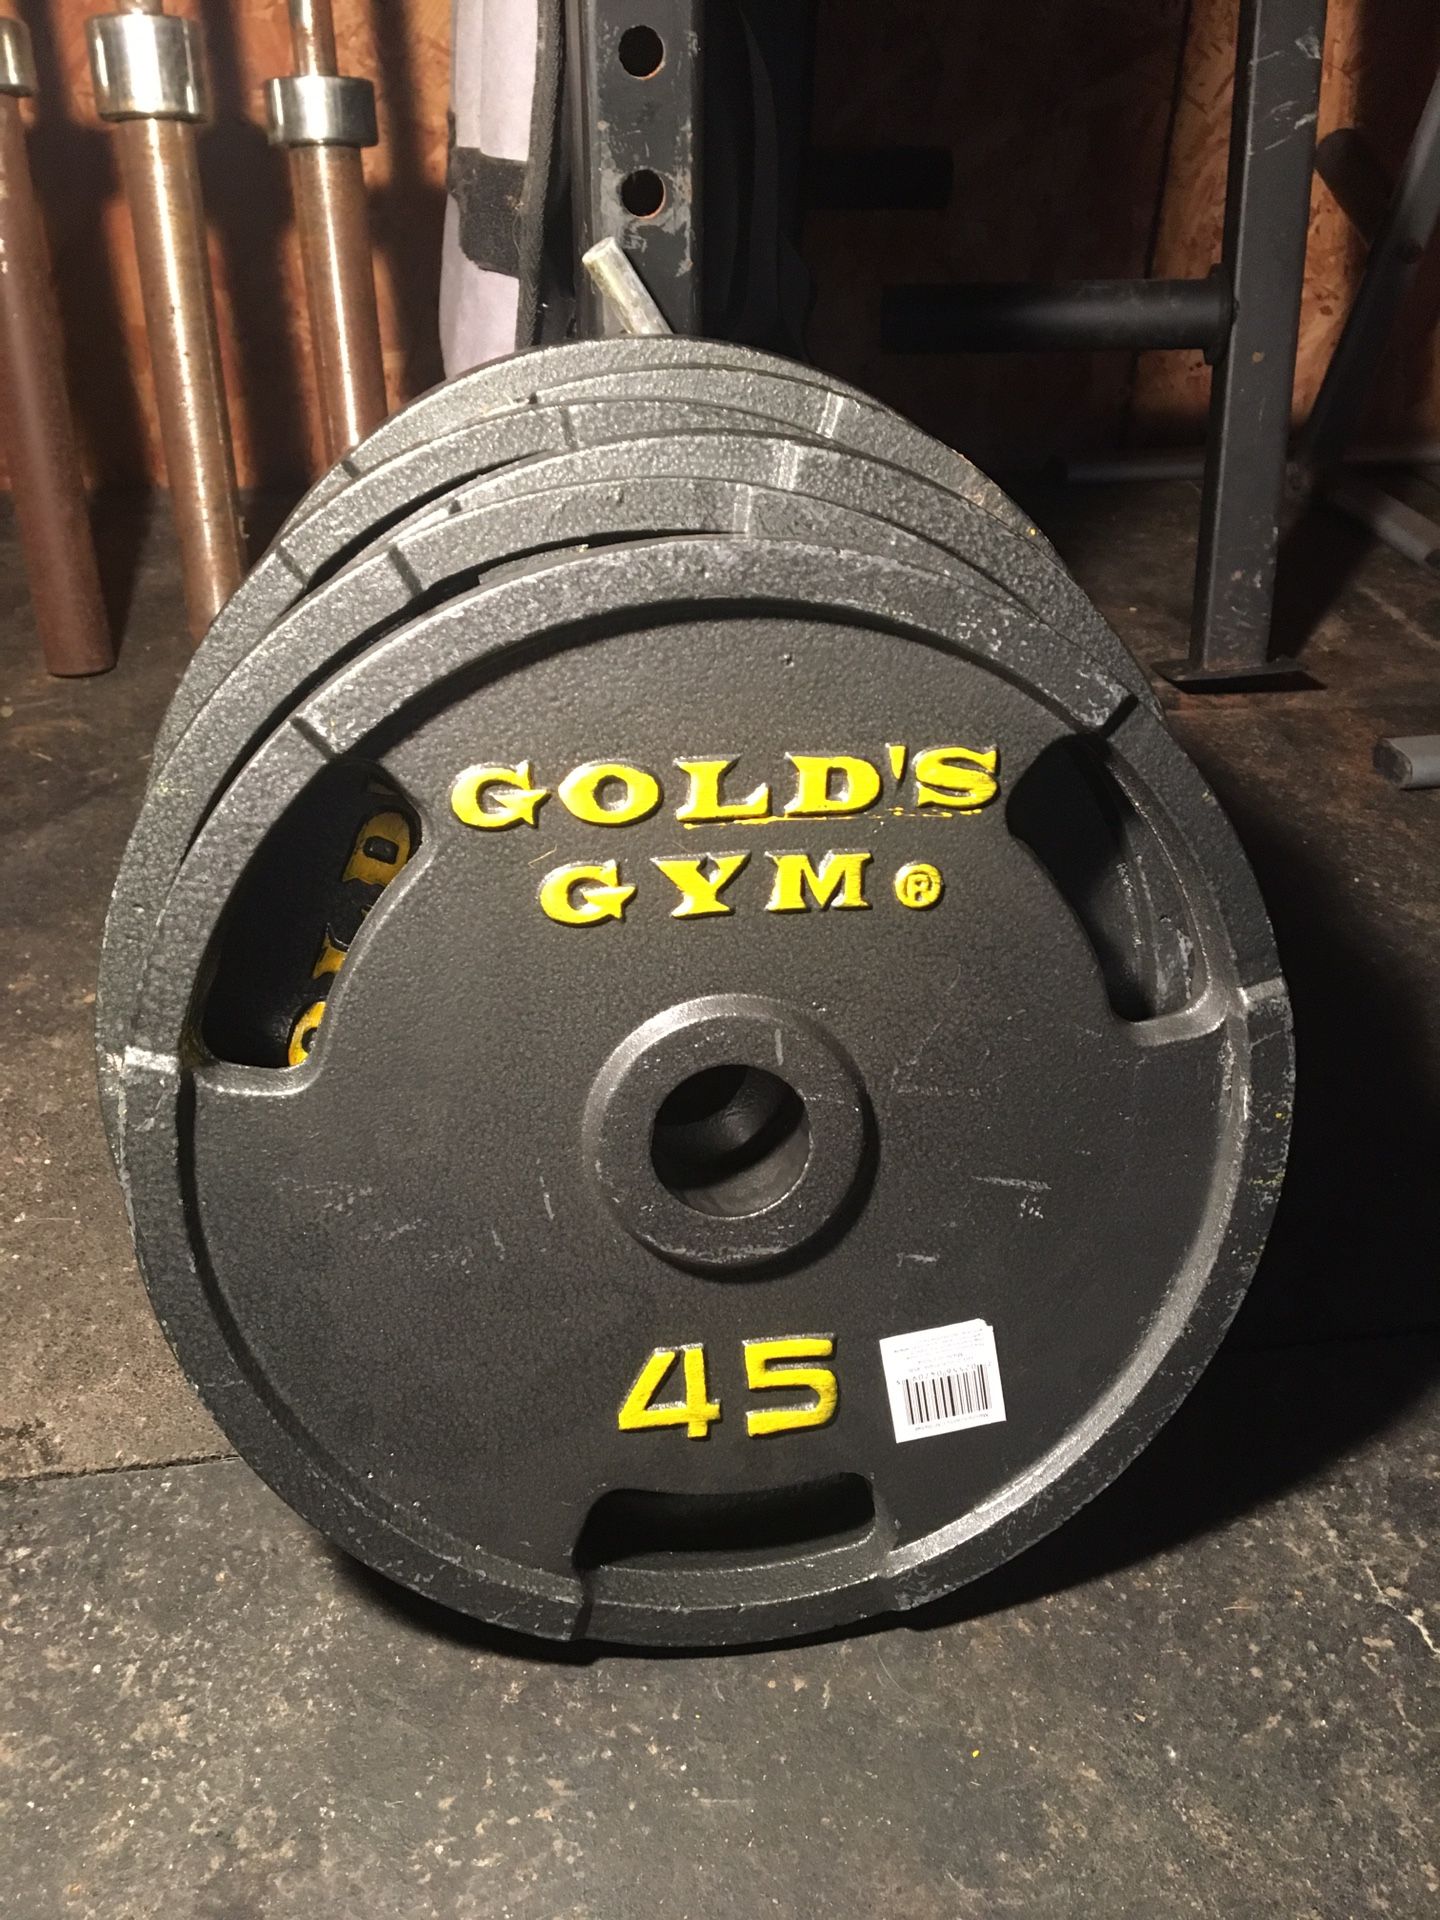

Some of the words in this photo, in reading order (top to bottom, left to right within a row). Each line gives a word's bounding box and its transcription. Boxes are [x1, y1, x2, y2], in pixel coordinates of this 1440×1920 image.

[450, 743, 1000, 829] GOLD'S
[538, 849, 873, 926] GYM
[617, 1332, 839, 1439] 45
